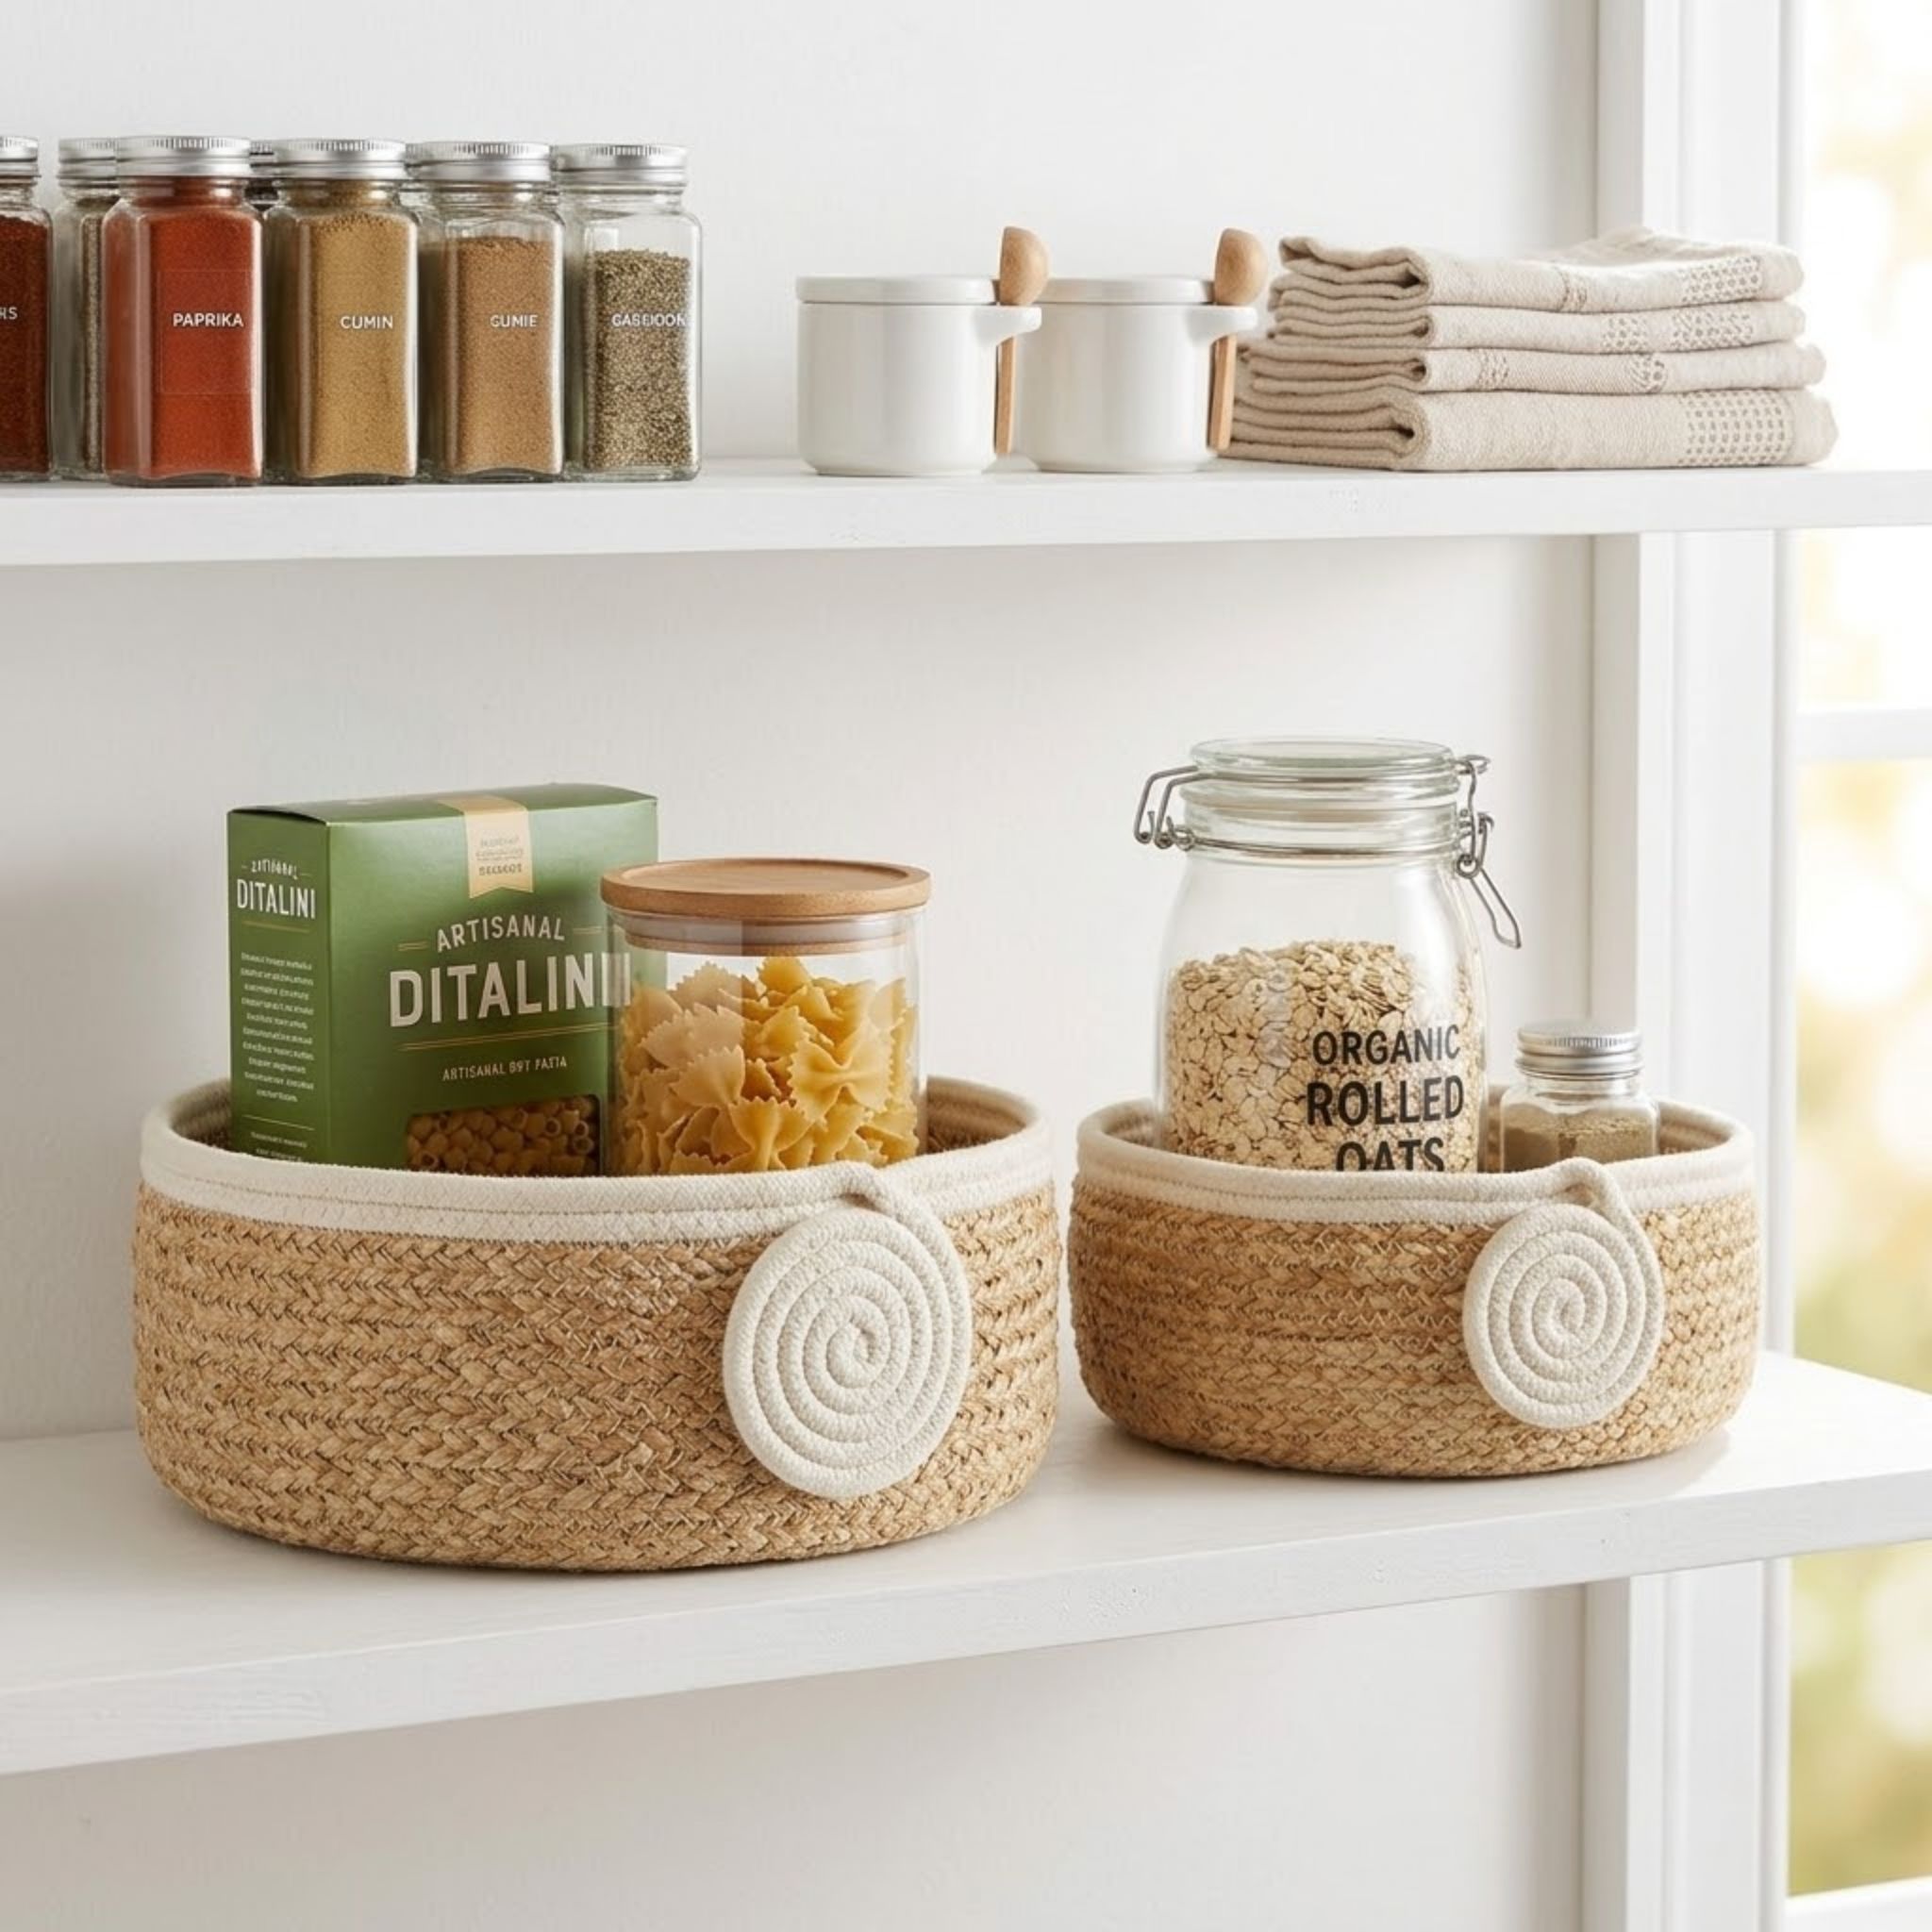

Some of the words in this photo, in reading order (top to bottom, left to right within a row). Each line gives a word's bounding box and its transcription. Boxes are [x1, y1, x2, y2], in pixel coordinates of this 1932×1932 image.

[173, 312, 244, 327] PAPRIKA
[340, 315, 393, 329] CUMIN
[237, 878, 316, 920] DITALINI
[437, 914, 565, 953] ARTISANAL
[1312, 1024, 1461, 1066] ORGANIC
[1307, 1074, 1464, 1127] ROLLED
[1336, 1137, 1444, 1172] OATS
